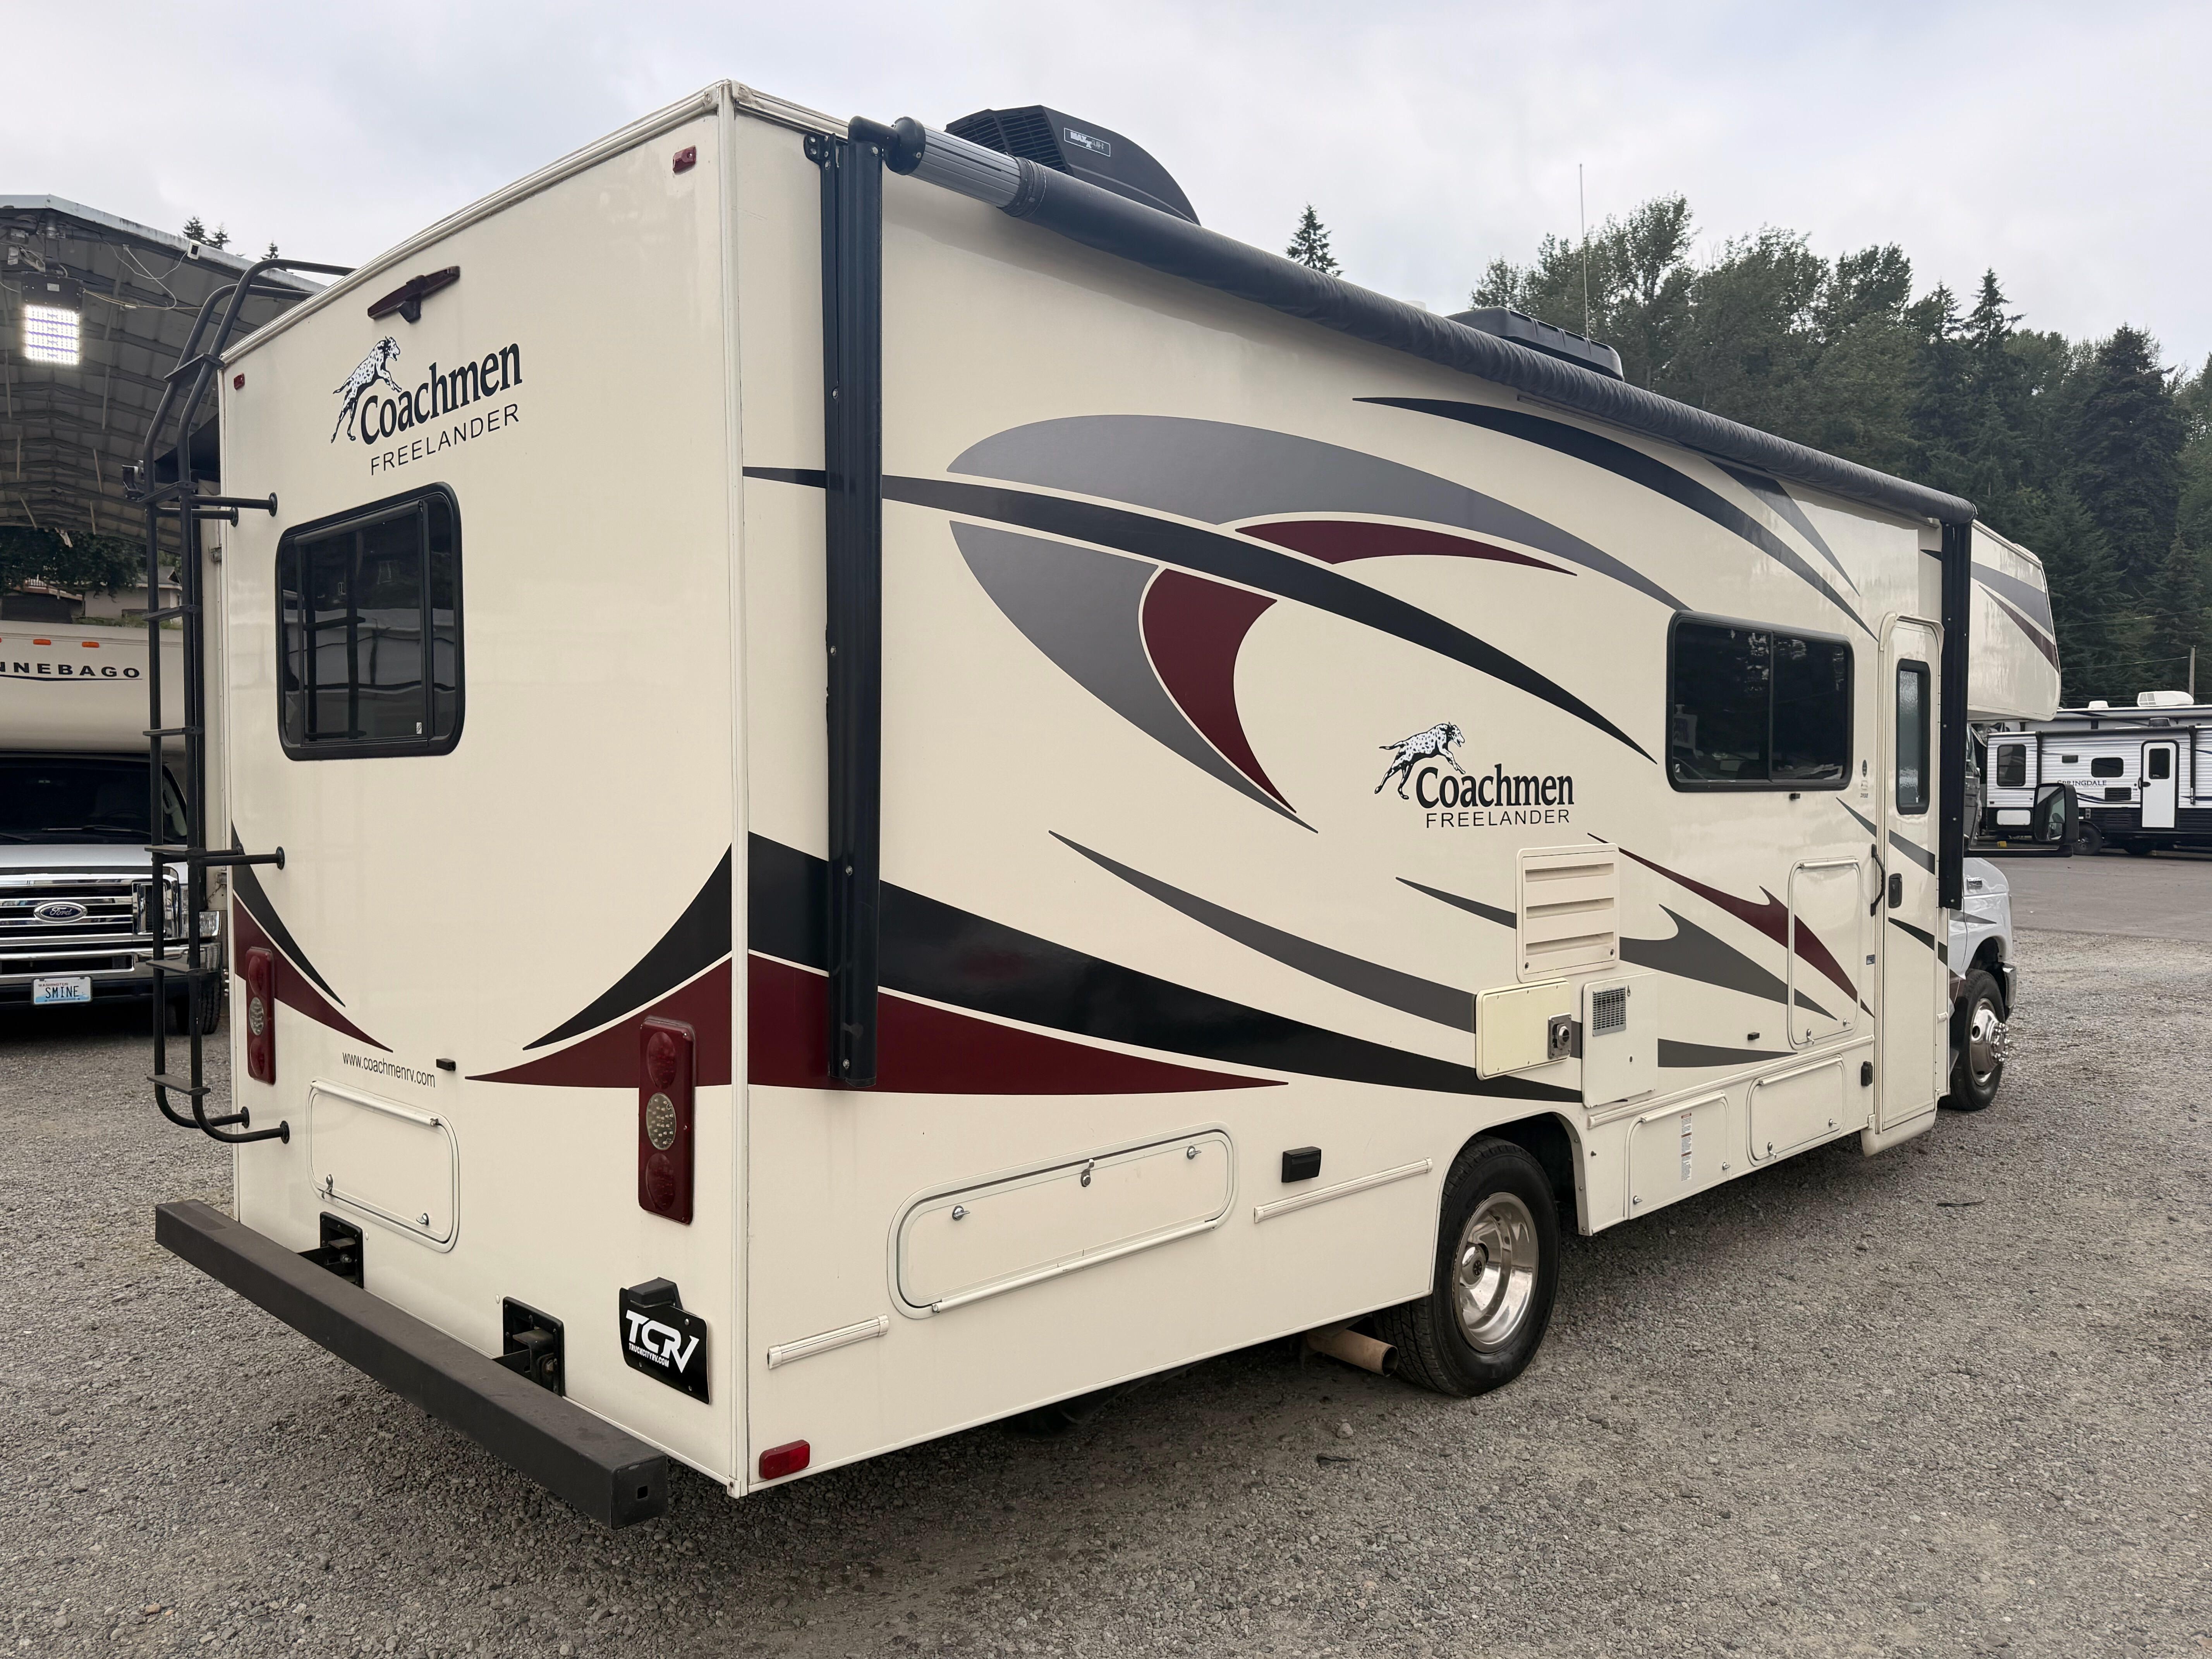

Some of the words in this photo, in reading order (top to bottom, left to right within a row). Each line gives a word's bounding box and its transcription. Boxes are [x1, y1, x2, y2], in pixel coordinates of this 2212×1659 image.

[361, 343, 522, 445] Coachmen
[371, 404, 519, 476] FREELANDER
[1416, 763, 1575, 809] Coachmen
[1426, 809, 1570, 828] FREELANDER
[50, 907, 72, 915] Ford
[45, 986, 80, 998] SMINE
[342, 1052, 435, 1087] www.coachmenrv.com
[629, 1343, 669, 1368] TRUCKCITYRV.COM
